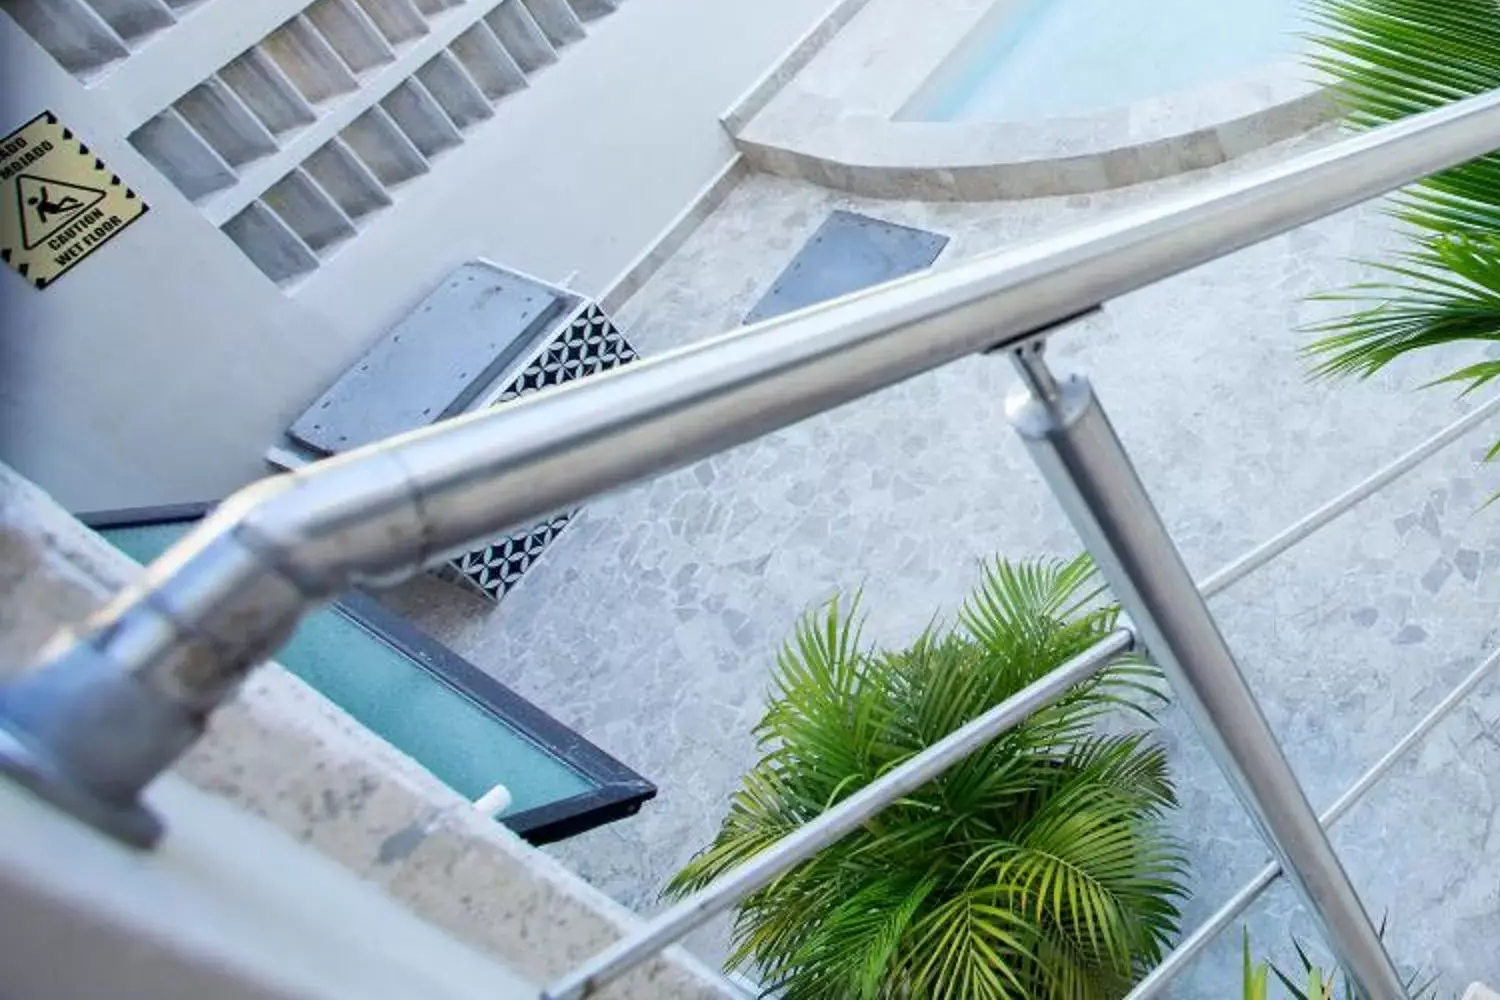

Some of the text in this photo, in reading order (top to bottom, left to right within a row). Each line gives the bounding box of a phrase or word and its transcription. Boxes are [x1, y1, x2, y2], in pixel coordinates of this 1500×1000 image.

[47, 207, 104, 251] CAUTION
[54, 215, 122, 266] WET FLOOR
